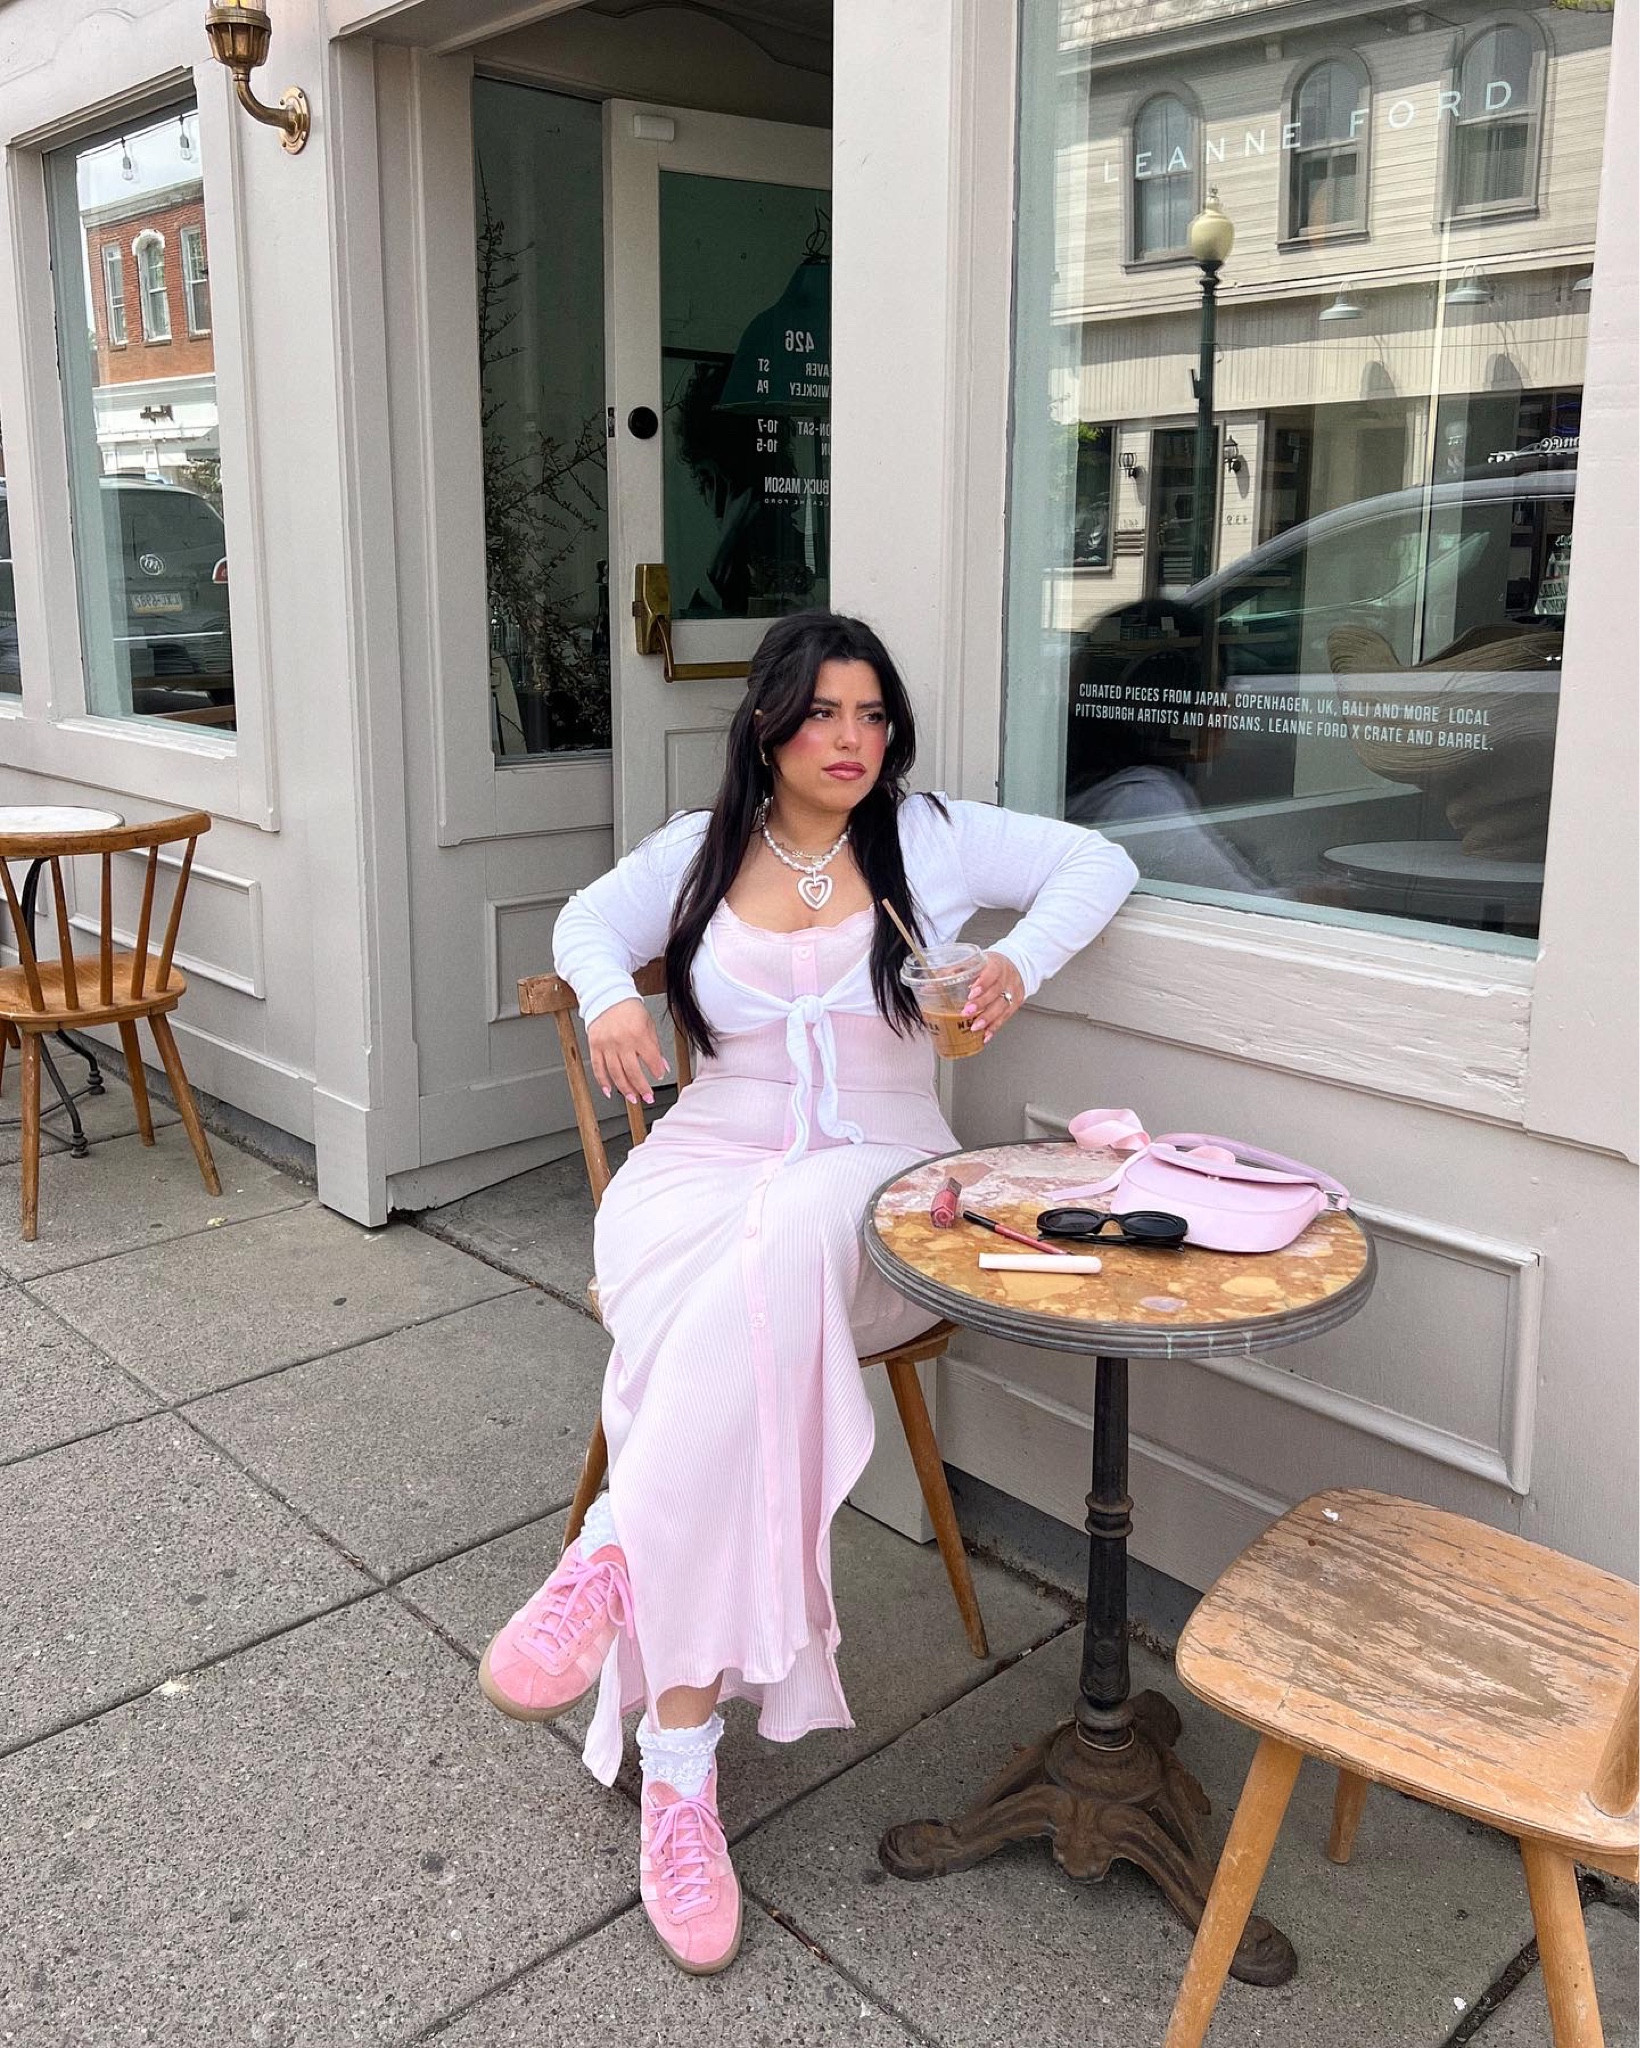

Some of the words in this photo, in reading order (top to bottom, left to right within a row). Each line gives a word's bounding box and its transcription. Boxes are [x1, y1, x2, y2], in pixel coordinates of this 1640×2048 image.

[1103, 122, 1302, 183] LEANNE
[1349, 80, 1512, 139] FORD
[1075, 702, 1134, 722] PITTSBURGH
[1137, 707, 1179, 725] ARTISTS
[1182, 710, 1204, 727] AND
[1207, 711, 1264, 732] ARTISANS.
[1268, 716, 1312, 736] LEANNE
[1316, 720, 1348, 739] FORD
[1352, 724, 1360, 740] X
[1364, 725, 1403, 744] CRATE
[1407, 728, 1434, 746] AND
[1437, 730, 1494, 751] BARREL.
[1079, 683, 1122, 700] CURATED
[1125, 687, 1160, 702] PIECES
[1162, 688, 1191, 704] FROM
[1194, 690, 1231, 708] JAPAN,
[1234, 693, 1312, 714] COPENHAGEN,
[1317, 698, 1338, 717] UK,
[1342, 700, 1369, 717] BALI
[1374, 703, 1399, 720] AND
[1403, 704, 1438, 722] MORE
[1448, 707, 1490, 726] LOCAL
